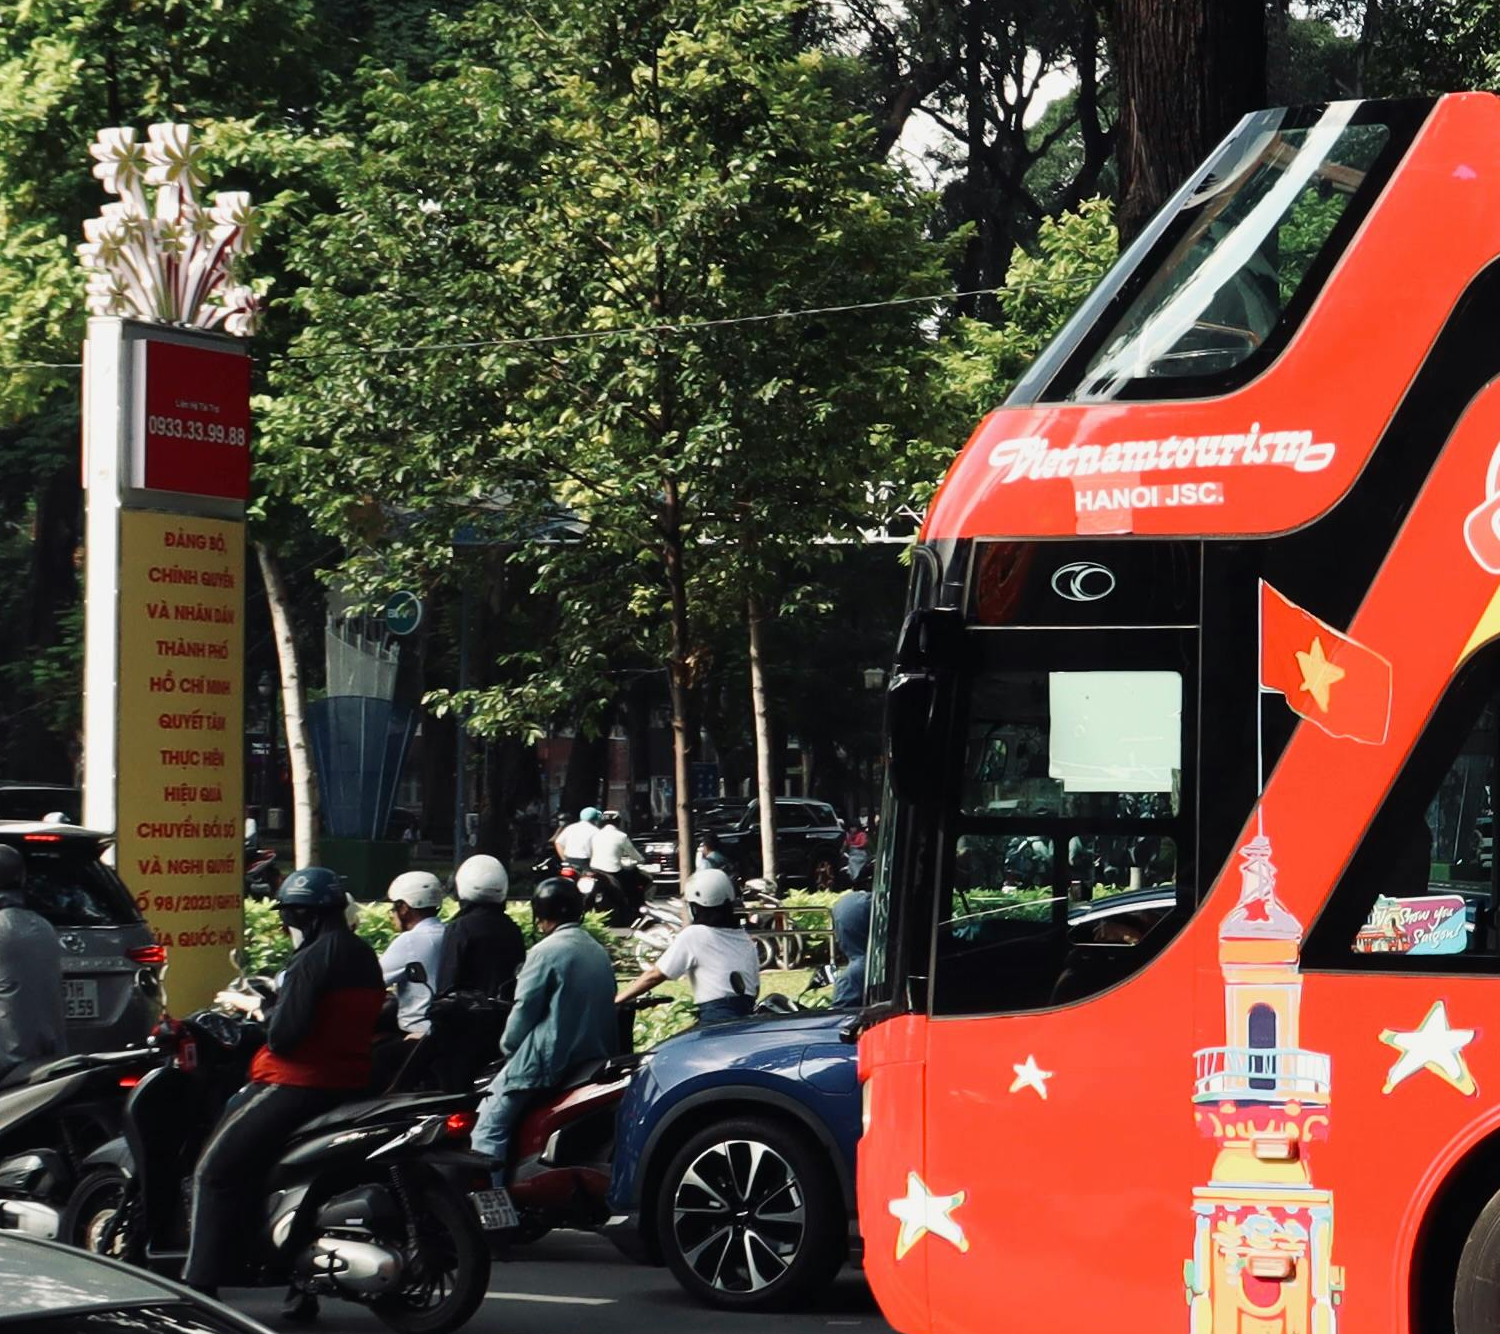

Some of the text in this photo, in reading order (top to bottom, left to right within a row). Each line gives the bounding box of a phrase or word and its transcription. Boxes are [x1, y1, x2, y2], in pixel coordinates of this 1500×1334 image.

[148, 415, 245, 446] 0933.33.99.88
[989, 422, 1335, 483] Vietnamtourism
[1075, 482, 1224, 513] HANOI JSC.
[164, 528, 206, 550] ĐẢNG
[148, 565, 198, 584] CHÍNH
[147, 600, 170, 619] VÀ
[175, 603, 211, 622] NHÂN
[156, 637, 229, 659] THÀNH PHỐ
[149, 669, 175, 692] HỒ
[179, 674, 204, 694] CHÍ
[159, 709, 203, 730] QUYẾT
[159, 750, 200, 770] THỰC
[164, 783, 197, 807] HIỆU
[138, 855, 163, 875] VÀ
[167, 859, 203, 877] NGHỊ
[135, 889, 149, 911] Ố
[1400, 907, 1430, 926] Show
[1428, 906, 1455, 932] you
[178, 924, 217, 947] QUỐC
